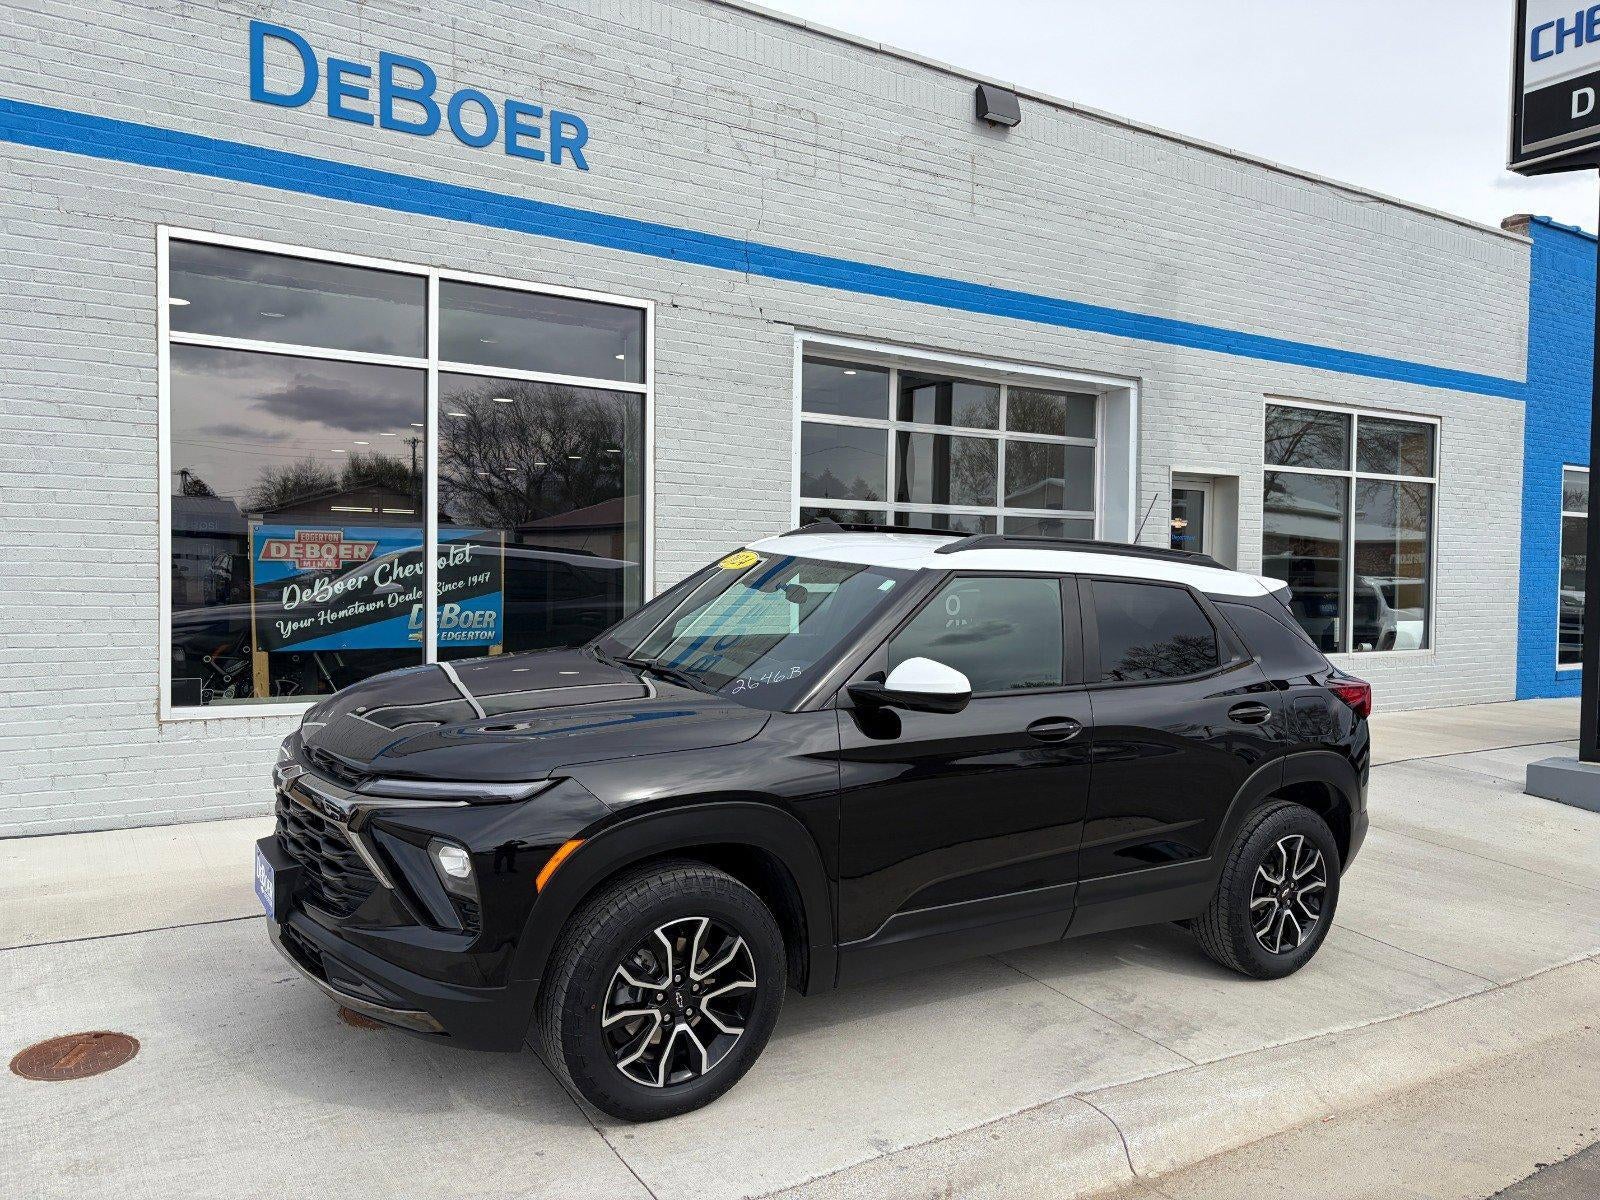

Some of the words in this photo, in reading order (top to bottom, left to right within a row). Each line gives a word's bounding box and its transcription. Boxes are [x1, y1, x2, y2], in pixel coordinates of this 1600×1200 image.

[249, 19, 590, 171] DEBOER
[270, 543, 368, 559] DEBOER
[300, 533, 340, 542] EDGERTON
[282, 576, 368, 610] DeBoer
[374, 543, 479, 587] Chevolet
[276, 617, 315, 639] Your
[317, 601, 386, 626] Hometown
[387, 587, 423, 608] Deale
[436, 579, 466, 597] Since
[467, 571, 491, 587] 1947
[441, 631, 496, 640] EDGERTON
